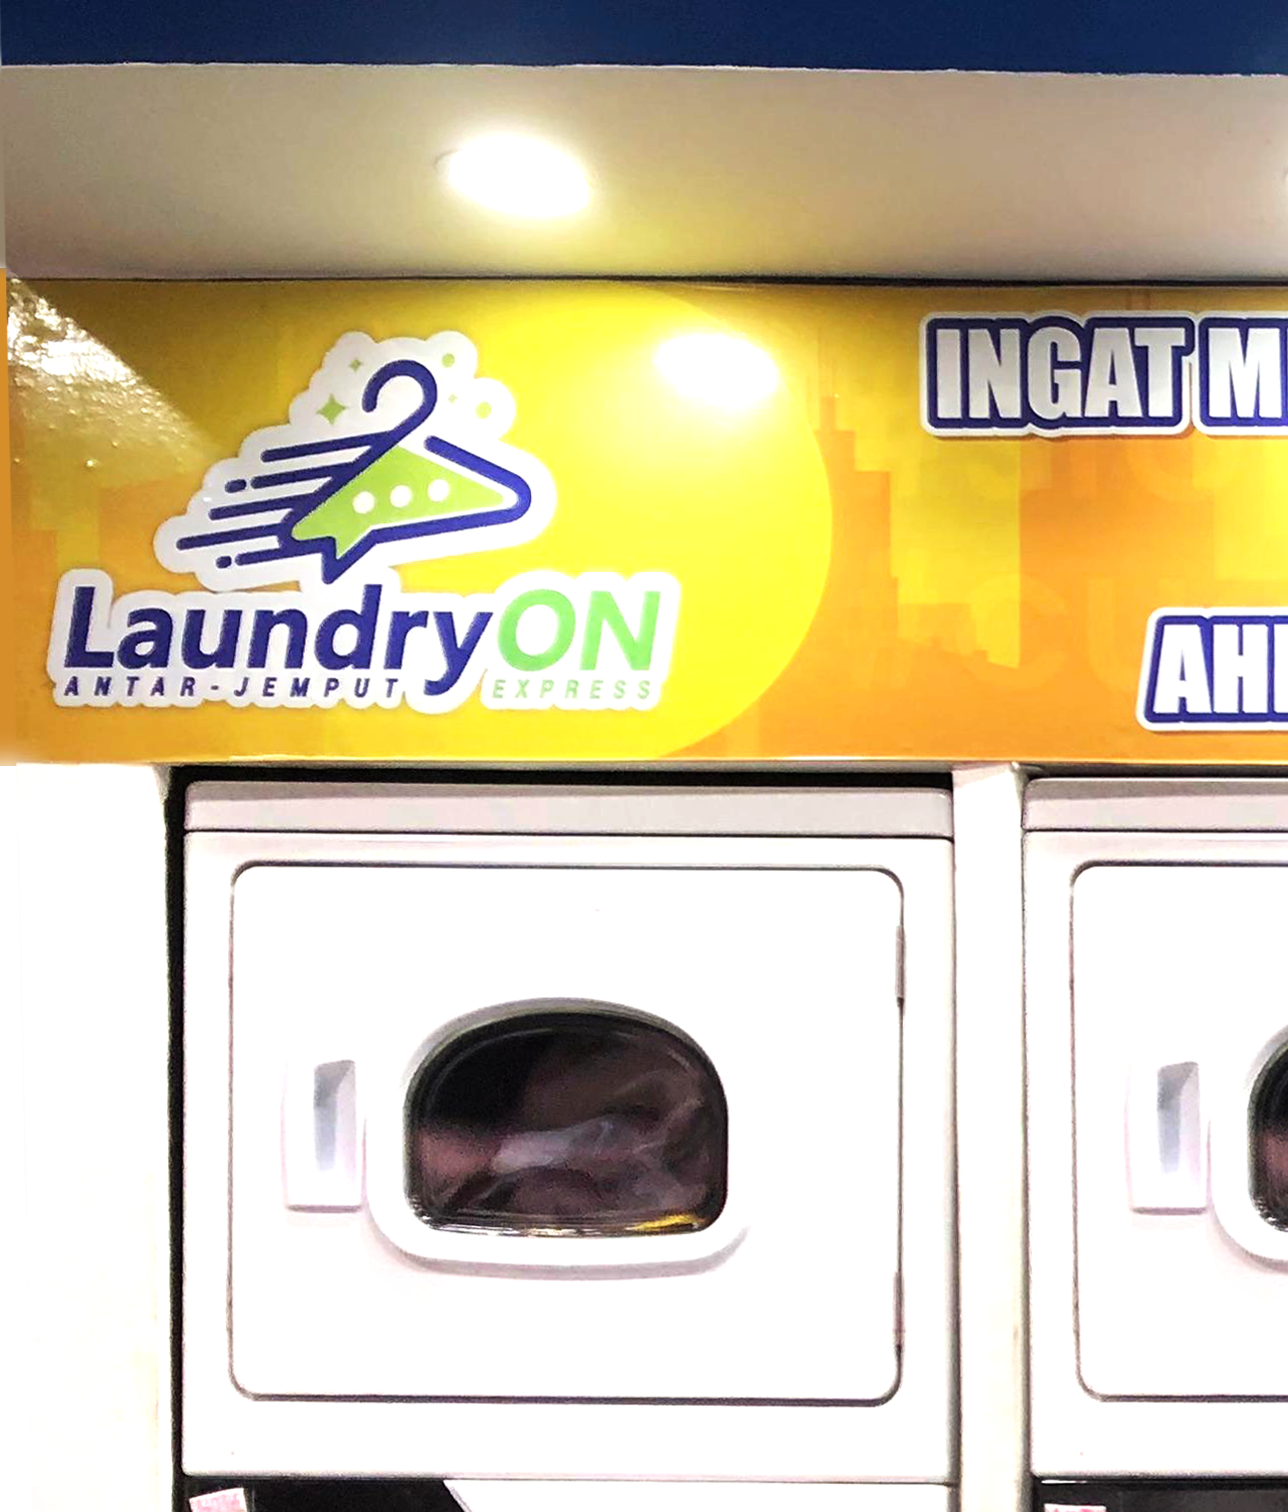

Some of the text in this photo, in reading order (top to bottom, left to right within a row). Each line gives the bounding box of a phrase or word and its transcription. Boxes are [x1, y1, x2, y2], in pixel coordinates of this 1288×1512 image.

[935, 328, 1189, 420] INGAT
[64, 584, 661, 696] LaundryON
[64, 678, 653, 700] ANTAR-JEMPUT EXPRESS
